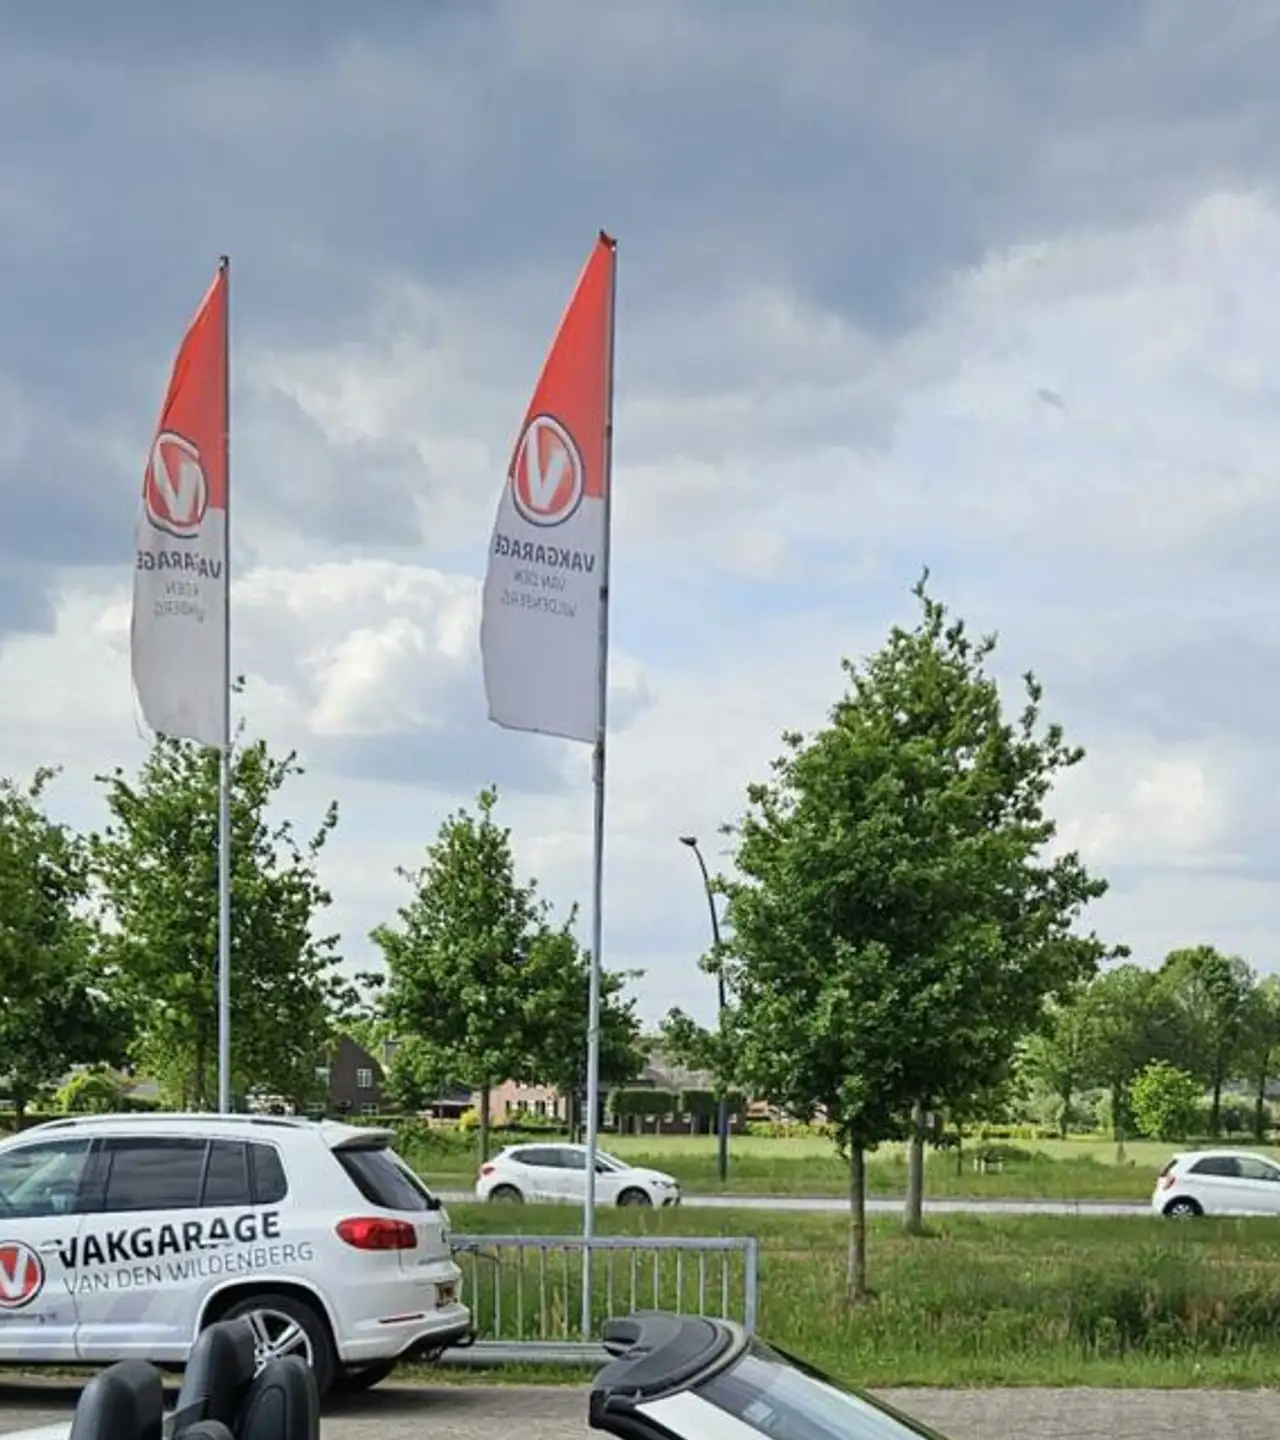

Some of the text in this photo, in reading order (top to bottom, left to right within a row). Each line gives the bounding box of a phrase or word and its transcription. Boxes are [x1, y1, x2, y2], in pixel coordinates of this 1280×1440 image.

[57, 1211, 281, 1269] VAKGARAGE
[63, 1241, 314, 1296] VAN DEN WILDENBERG
